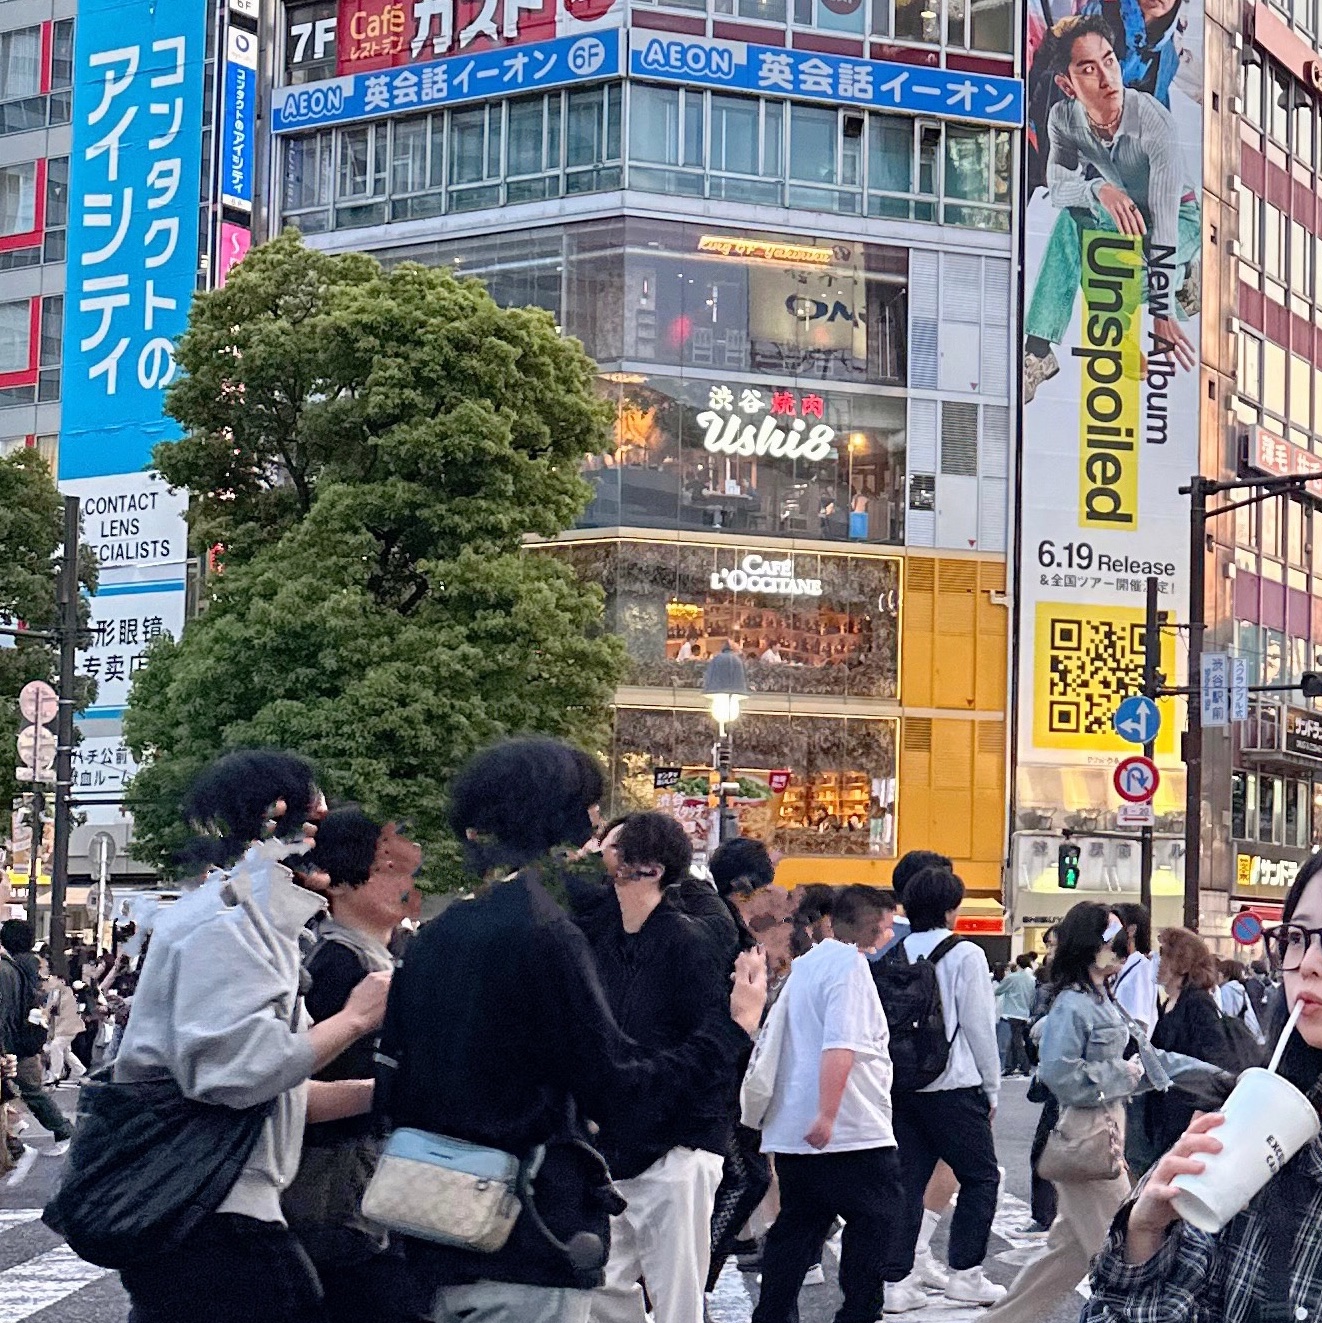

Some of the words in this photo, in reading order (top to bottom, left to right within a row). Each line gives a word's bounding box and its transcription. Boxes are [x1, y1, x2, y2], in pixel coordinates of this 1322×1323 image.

[290, 17, 337, 63] 7F
[350, 4, 405, 40] Café
[350, 36, 403, 60] レストラン
[643, 41, 734, 77] AEON
[364, 53, 558, 112] 英会話イーオン
[572, 44, 602, 68] 6F
[758, 51, 1014, 113] 英会話イーオン
[282, 85, 344, 121] AEON
[80, 45, 141, 395] アイシティ
[138, 35, 186, 390] コンタクトの
[1147, 244, 1176, 321] New
[1071, 236, 1135, 523] Unspoiled
[1146, 330, 1175, 445] Album
[697, 410, 836, 462] Ushi8
[84, 492, 159, 515] CONTACT
[101, 518, 140, 539] LENS
[710, 567, 822, 596] L'OCCITANE
[1038, 540, 1094, 570] 6.19
[1098, 553, 1176, 577] Release
[96, 615, 164, 647] 形眼镜
[1212, 657, 1224, 720] 渋谷駅前
